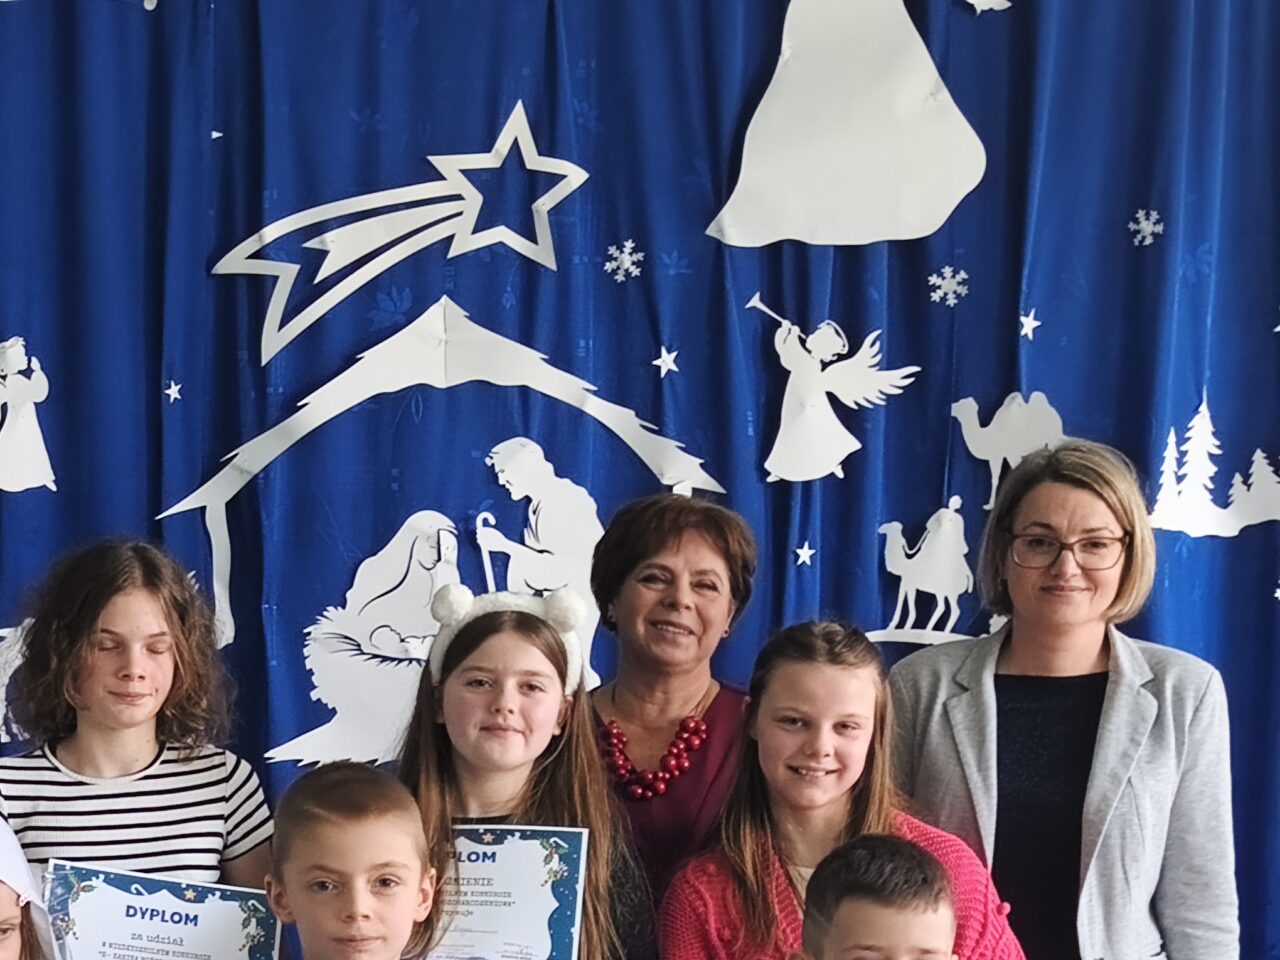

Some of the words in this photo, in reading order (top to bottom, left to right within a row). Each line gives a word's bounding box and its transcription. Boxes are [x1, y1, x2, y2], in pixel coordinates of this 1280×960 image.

[125, 904, 199, 927] DYPLOM
[131, 932, 143, 941] za
[146, 934, 185, 947] udział
